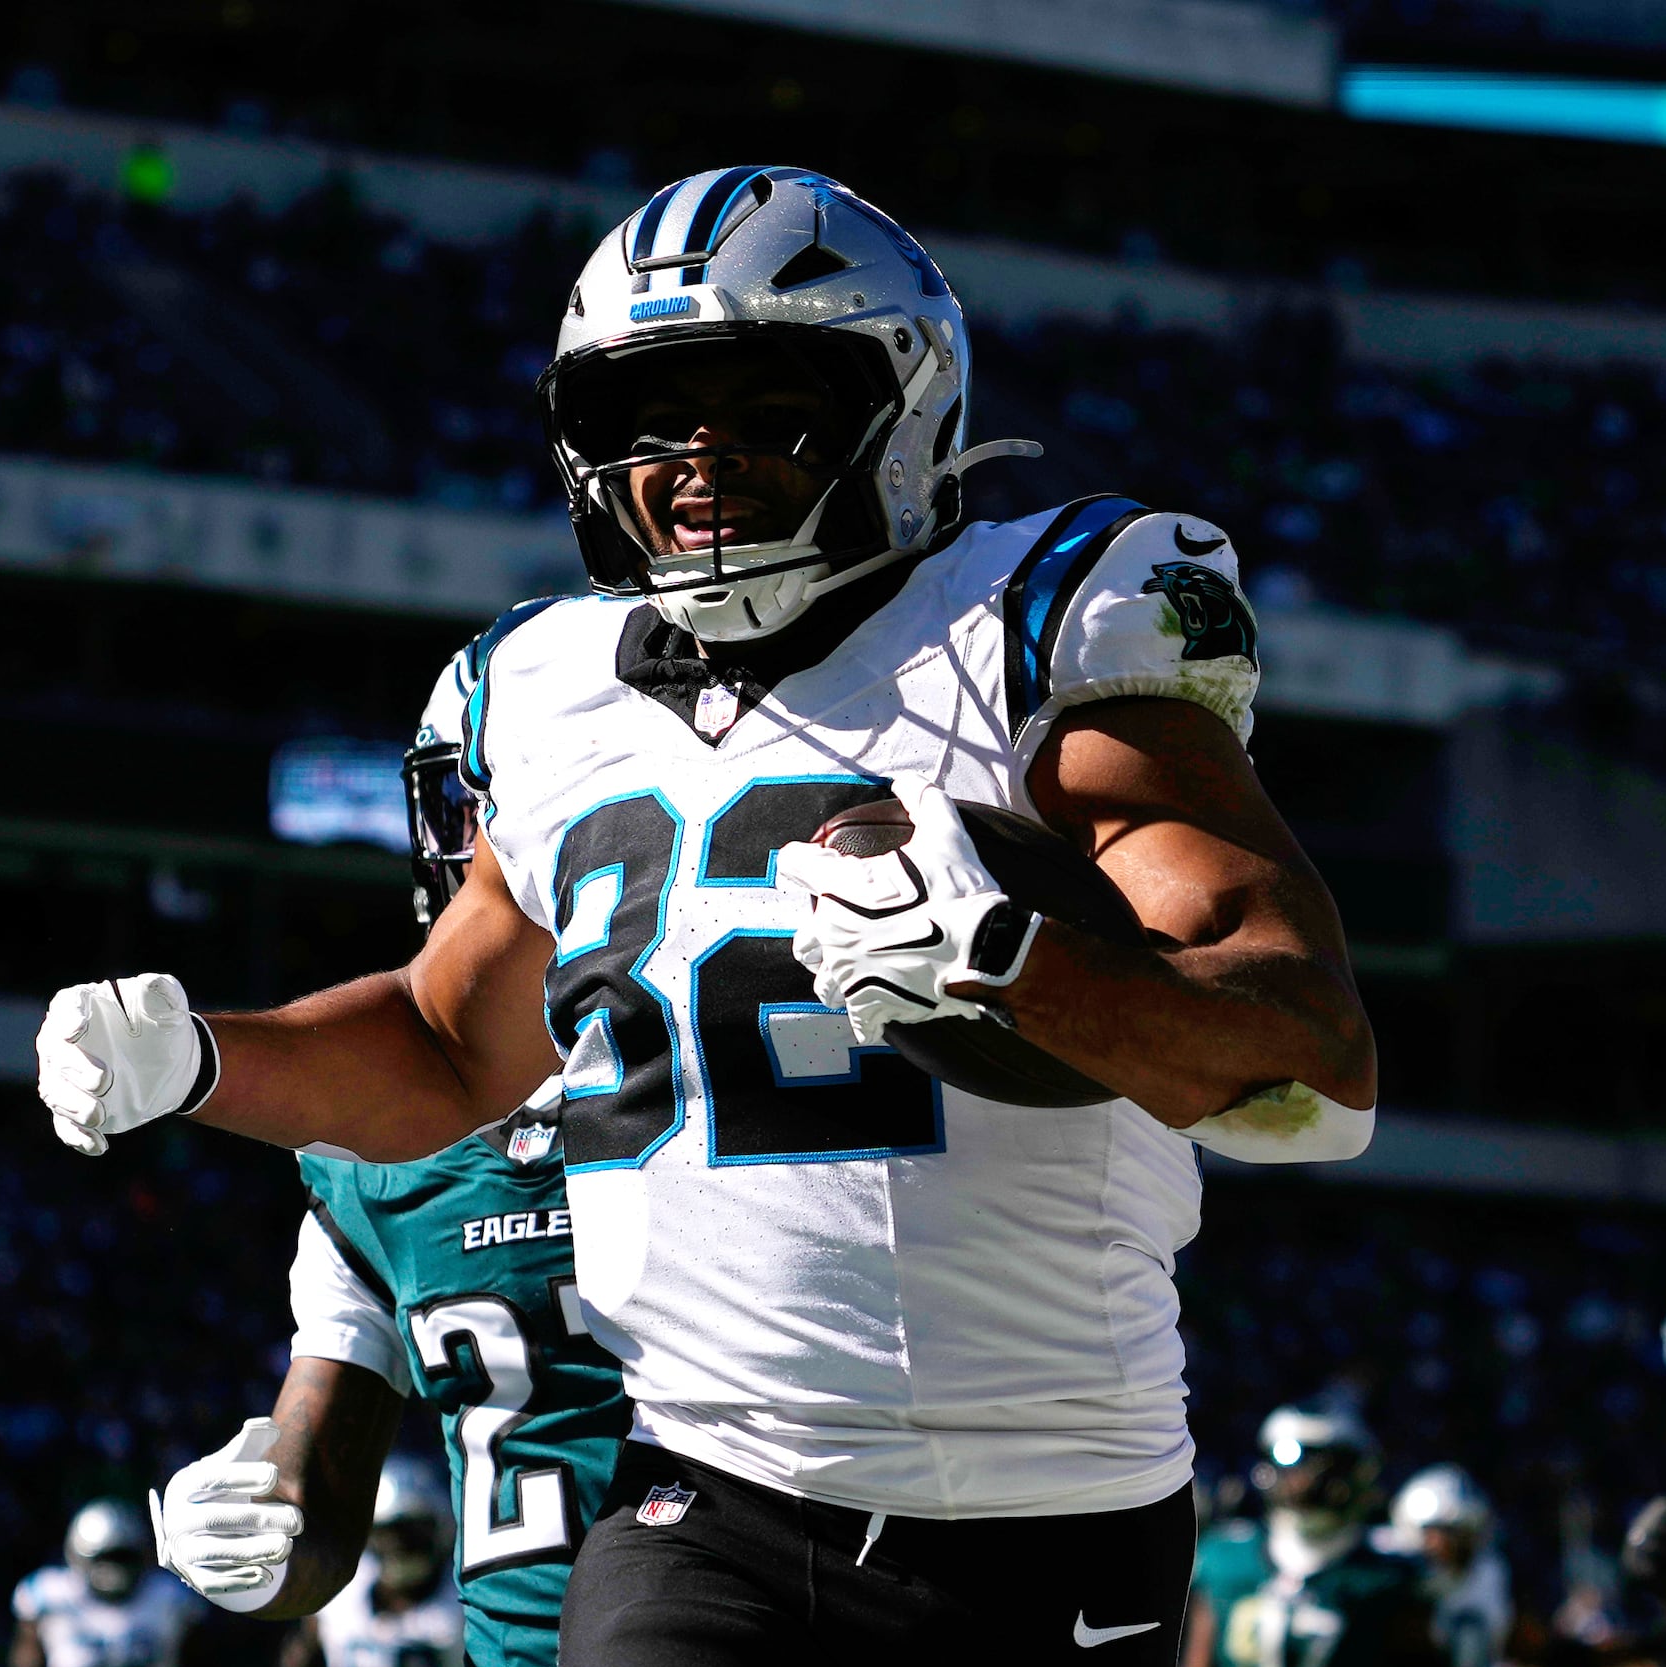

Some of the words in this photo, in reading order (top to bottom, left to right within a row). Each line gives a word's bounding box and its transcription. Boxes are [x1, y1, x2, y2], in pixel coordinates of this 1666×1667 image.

[629, 295, 691, 321] CAROLINA
[462, 1208, 573, 1253] EAGLE
[406, 1273, 591, 1582] 2
[645, 1501, 677, 1519] NFL
